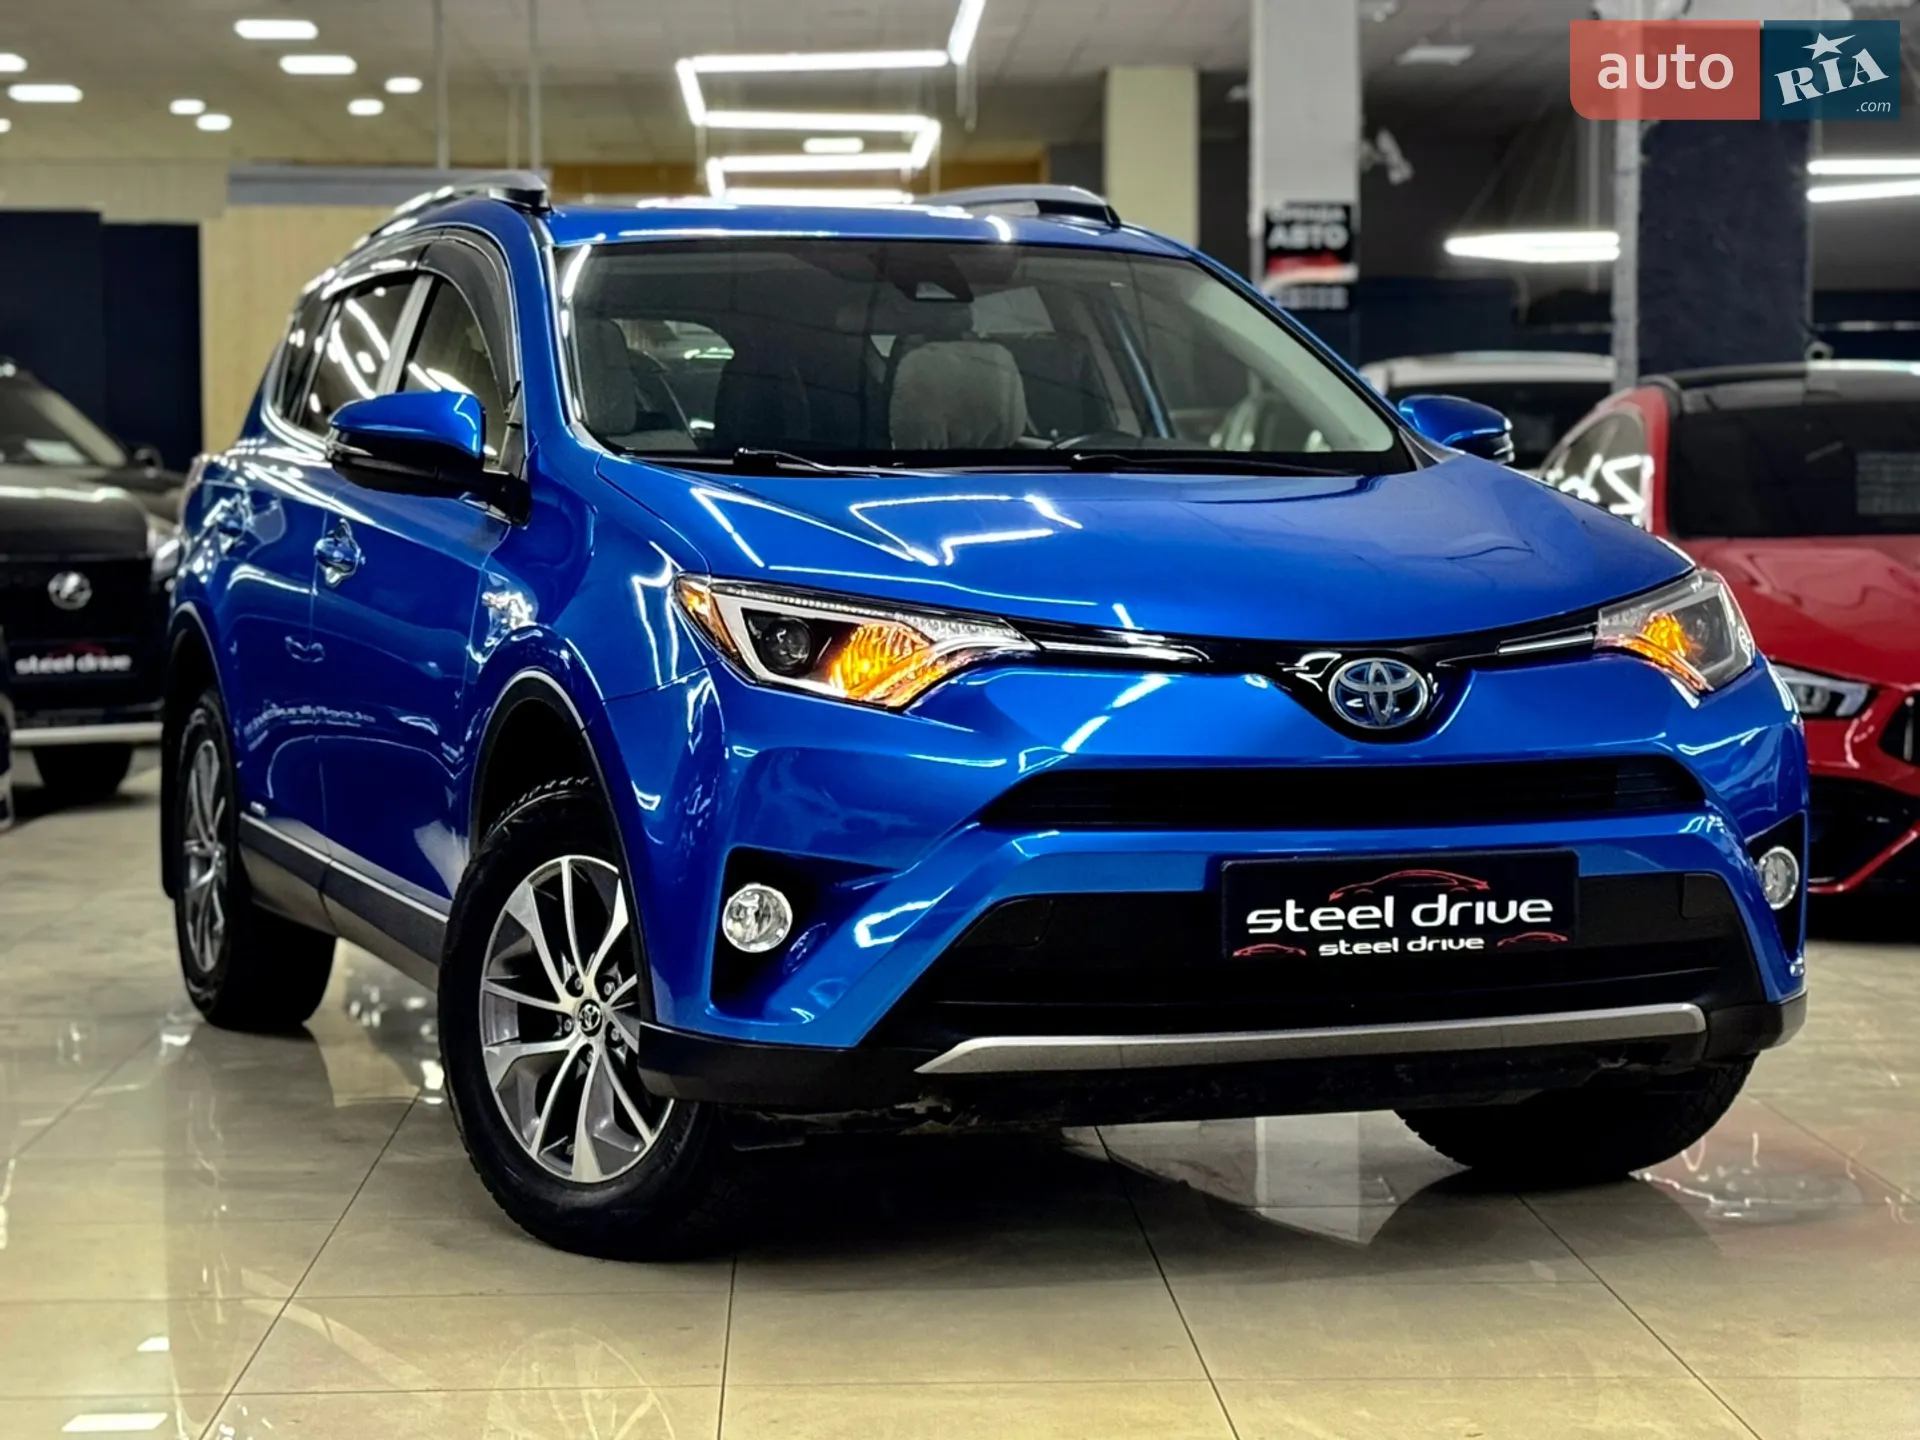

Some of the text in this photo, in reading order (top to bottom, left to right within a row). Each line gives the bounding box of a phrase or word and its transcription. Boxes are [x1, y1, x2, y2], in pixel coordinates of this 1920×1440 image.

[1267, 223, 1349, 250] АВТО
[1246, 893, 1554, 934] steel drive
[1318, 935, 1486, 957] steel drive
